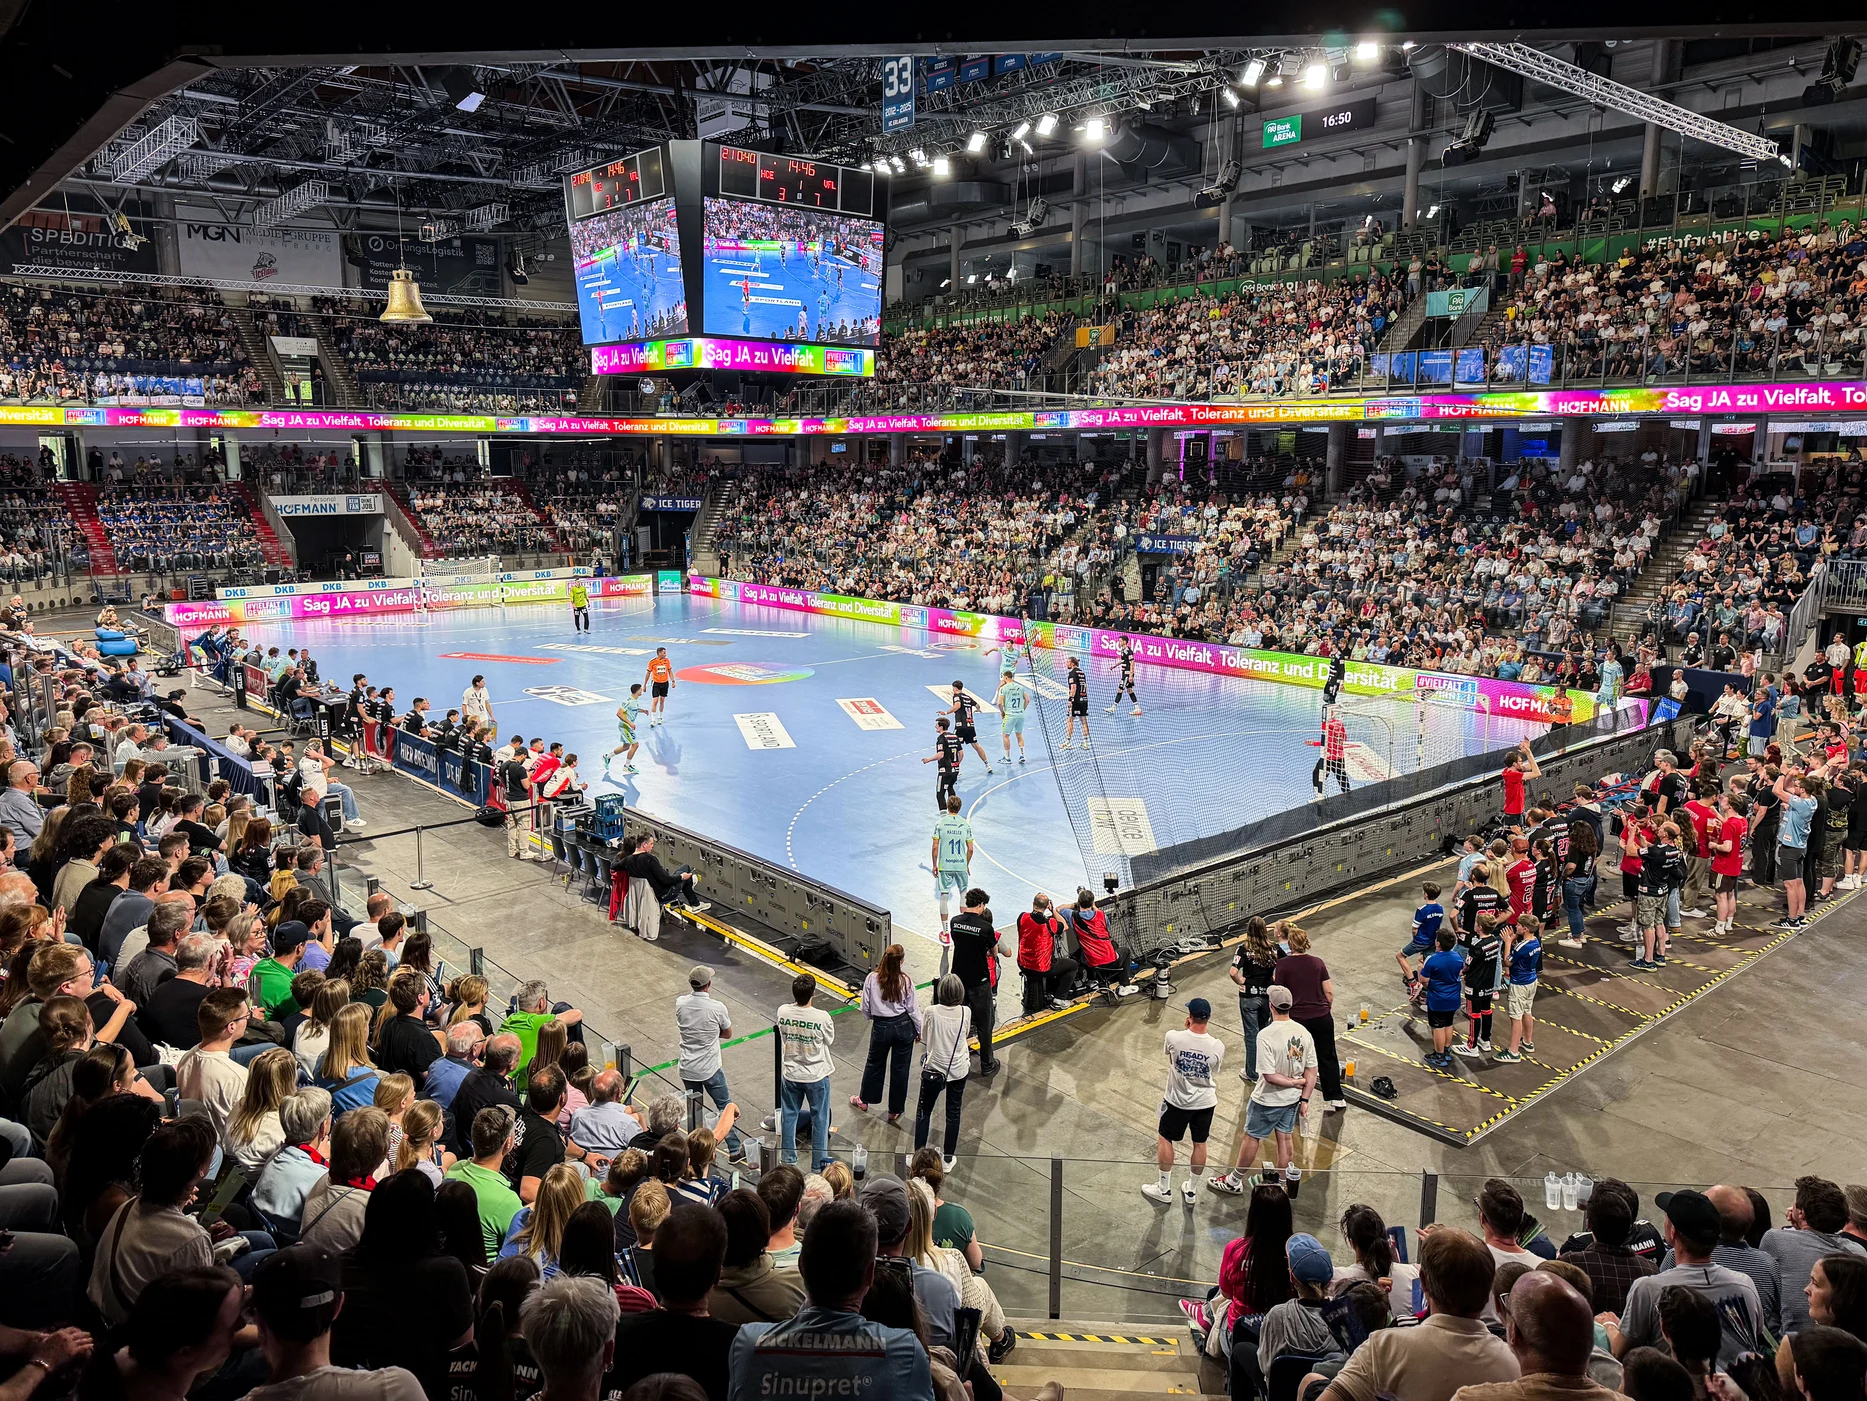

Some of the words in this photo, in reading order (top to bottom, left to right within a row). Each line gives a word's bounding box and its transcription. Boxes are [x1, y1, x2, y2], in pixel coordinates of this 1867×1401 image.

[885, 57, 912, 97] 33
[1322, 112, 1352, 128] 16:50
[1273, 131, 1296, 142] ARENA
[761, 169, 775, 180] HCE
[823, 180, 837, 190] VFL
[605, 194, 611, 208] 3
[778, 187, 786, 201] 3
[814, 193, 821, 206] 7
[31, 228, 128, 248] SPEDITIO
[187, 224, 240, 243] MGN
[245, 228, 331, 243] MEDIEGRUPPE
[31, 245, 126, 261] Partnerschaft,
[32, 256, 52, 265] die
[1449, 303, 1464, 312] Bank
[594, 351, 608, 371] Sag
[609, 349, 619, 366] JA
[621, 351, 630, 364] zu
[631, 344, 659, 364] Vielfalt
[707, 346, 731, 367] Sag
[735, 347, 751, 363] JA
[754, 350, 768, 364] zu
[772, 347, 815, 368] Vielfalt
[826, 351, 855, 362] #VIELFALT
[826, 361, 855, 371] GEWINNT
[1483, 396, 1515, 404] Personal
[1599, 392, 1630, 400] Personal
[1667, 391, 1702, 411] Sag
[1707, 391, 1731, 407] JA
[1736, 393, 1757, 406] zu
[1763, 387, 1835, 406] Vielfalt,
[1558, 400, 1630, 413] HOFMANN
[119, 416, 168, 425] HOFMANN
[187, 417, 239, 426] HOFMANN
[262, 415, 285, 427] Sag
[288, 415, 303, 425] JA
[306, 417, 319, 426] zu
[322, 415, 364, 427] Vielfalt,
[367, 416, 411, 427] Toleranz
[415, 417, 431, 427] und
[437, 418, 486, 429] Diversität
[1081, 412, 1102, 425] Sag
[1106, 411, 1121, 423] JA
[1123, 413, 1137, 422] zu
[1140, 409, 1187, 422] Vielfalt,
[1190, 407, 1244, 420] Toleranz
[1248, 406, 1274, 418] und
[539, 420, 556, 431] Sag
[558, 421, 568, 430] JA
[570, 422, 580, 430] zu
[582, 420, 610, 431] Vielfalt,
[613, 421, 648, 432] Toleranz
[650, 421, 667, 432] und
[669, 421, 710, 432] Diversität
[849, 420, 863, 431] Sag
[865, 421, 875, 430] JA
[888, 419, 919, 430] Vielfalt,
[921, 418, 956, 428] Toleranz
[959, 417, 976, 427] und
[978, 415, 1024, 426] Diversität
[275, 503, 337, 515] HOFMANN
[659, 499, 673, 508] ICE
[676, 500, 701, 508] TIGER
[1154, 540, 1166, 549] ICE
[274, 586, 295, 594] DKB
[322, 583, 342, 591] DKB
[368, 580, 387, 588] DKB
[609, 583, 646, 593] HOFMANN
[225, 589, 246, 597] DKB
[303, 598, 330, 613] Sag
[333, 597, 351, 608] JA
[354, 598, 370, 607] zu
[424, 589, 474, 602] Toleranz
[477, 587, 500, 599] und
[503, 584, 556, 597] Diversität
[744, 586, 758, 601] Sag
[759, 588, 768, 600] JA
[769, 591, 777, 601] zu
[778, 590, 805, 607] Vielfalt,
[806, 595, 836, 610] Toleranz
[838, 597, 853, 612] und
[855, 601, 893, 618] Diversität
[176, 610, 230, 622] HOFMANN
[938, 618, 971, 631] HOFMANN
[1147, 644, 1162, 657] zu
[1165, 641, 1216, 667] Vielfalt,
[1219, 650, 1279, 674] Toleranz
[1284, 660, 1314, 678] und
[1318, 664, 1398, 690] Dersität
[1418, 675, 1463, 691] #VIELFALT
[1011, 698, 1021, 709] 27
[400, 742, 414, 762] HIER
[949, 839, 961, 855] 11
[1557, 837, 1570, 856] 27
[953, 922, 981, 934] SICHERHEIT
[780, 1017, 822, 1030] GARDEN
[1180, 1050, 1210, 1062] READY
[756, 1335, 886, 1351] FACKELMANN
